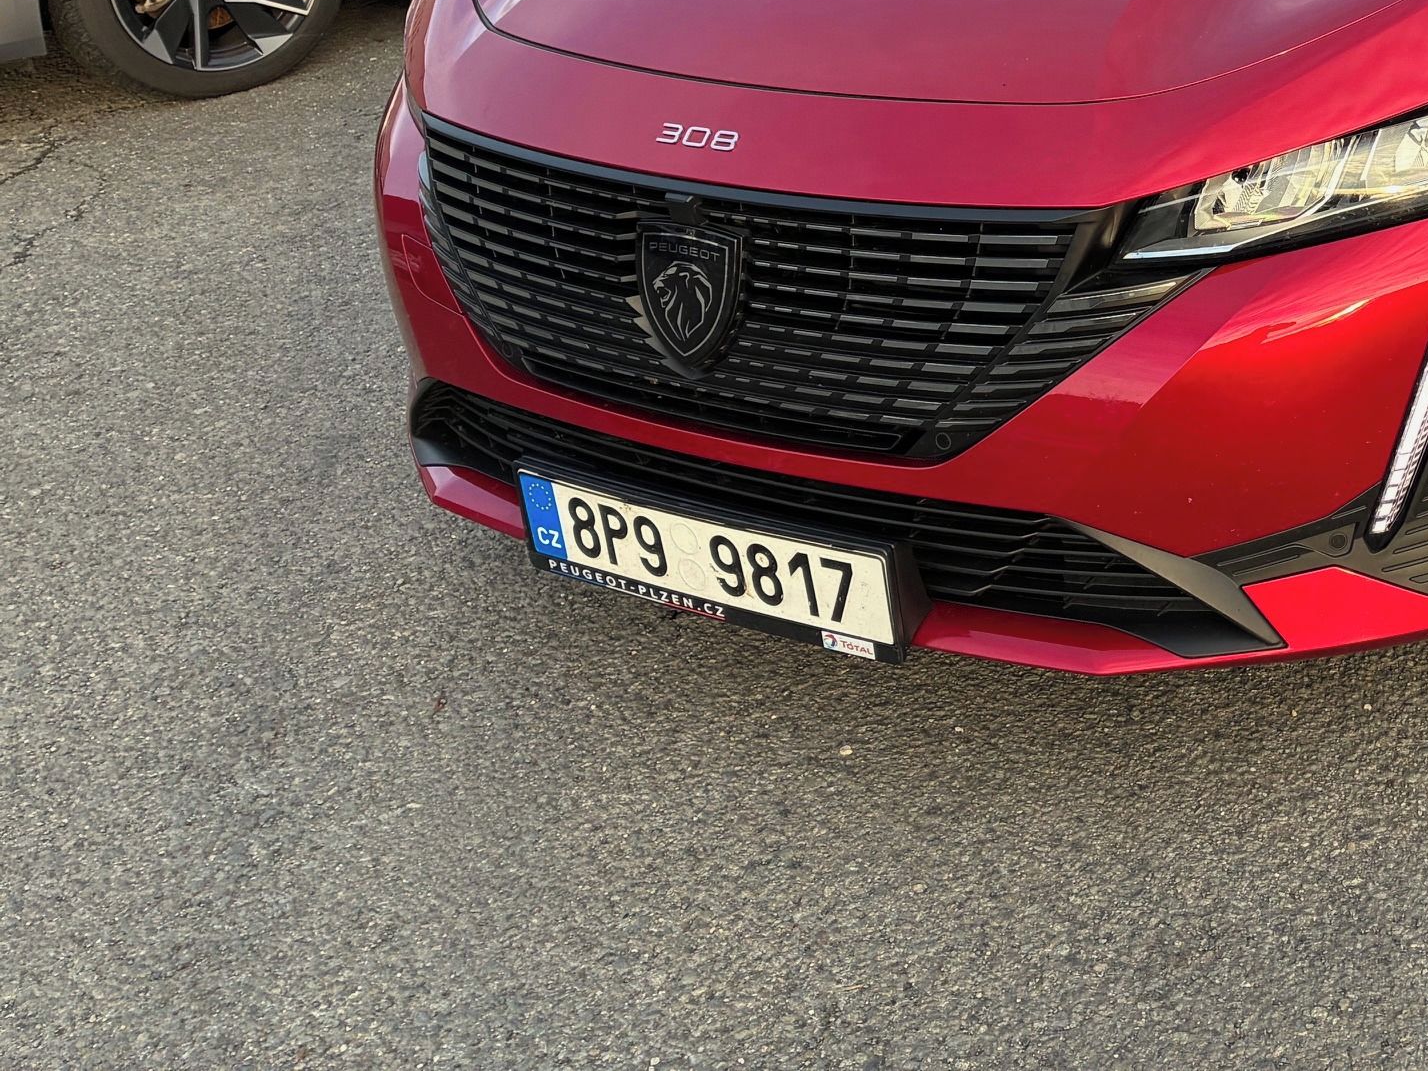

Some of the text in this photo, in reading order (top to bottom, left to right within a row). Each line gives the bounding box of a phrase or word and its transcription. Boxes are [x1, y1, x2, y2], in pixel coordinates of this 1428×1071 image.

[656, 122, 739, 152] 308
[649, 241, 720, 262] PEUGEOT
[537, 525, 563, 550] CZ
[568, 497, 854, 623] 8P9 9817
[548, 559, 726, 617] PEUGEOT-PLZEN.CZ
[840, 640, 874, 655] TOTAL
